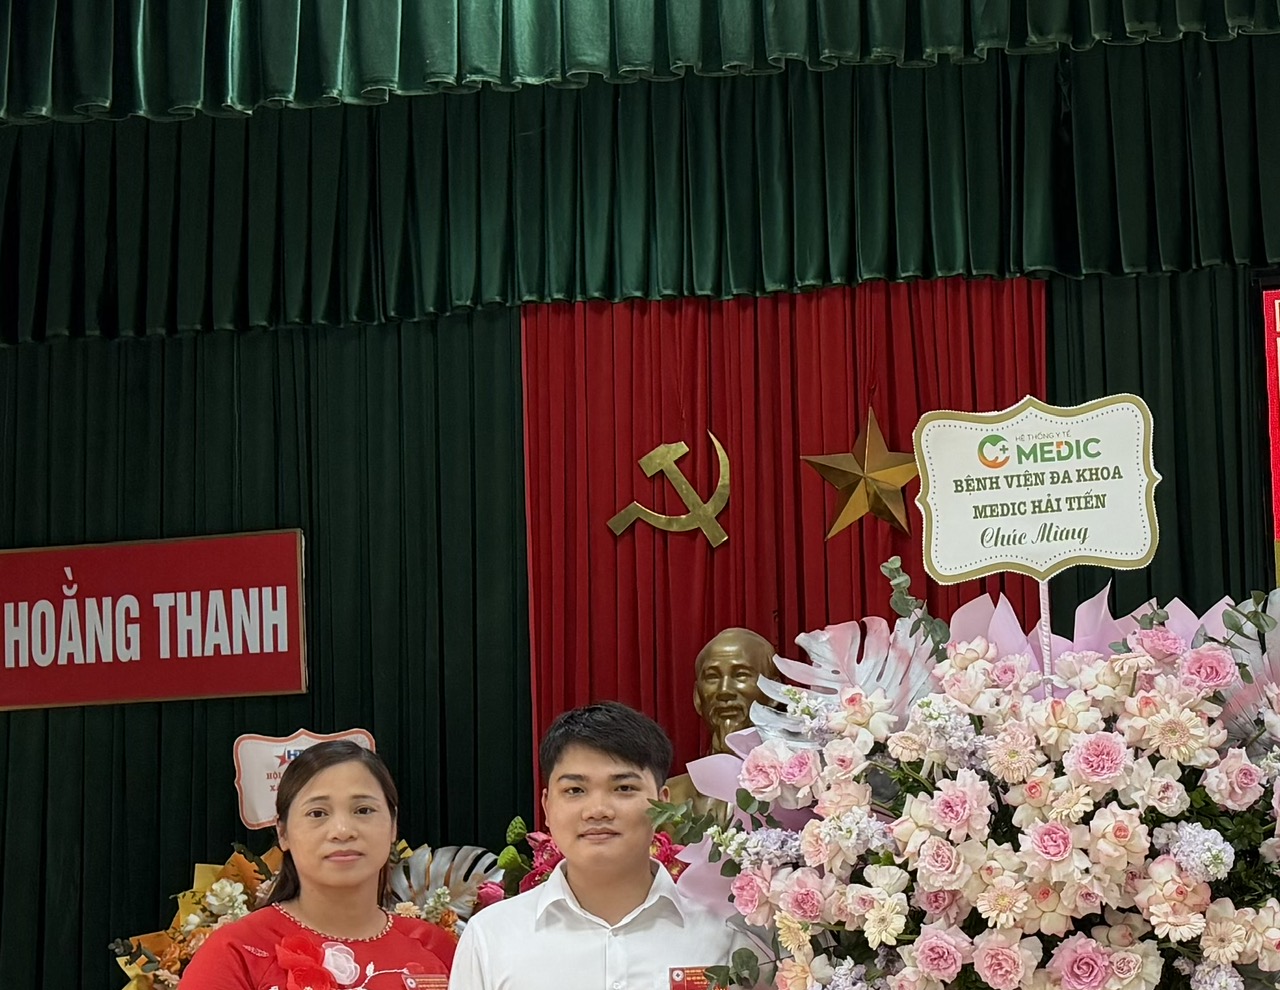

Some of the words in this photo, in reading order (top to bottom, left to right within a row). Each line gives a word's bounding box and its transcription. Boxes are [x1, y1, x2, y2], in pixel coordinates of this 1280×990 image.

[1016, 438, 1101, 464] MEDIC
[953, 474, 1000, 496] BỆNH
[1005, 470, 1045, 490] VIỆN
[1050, 468, 1073, 485] ĐA
[1076, 464, 1124, 482] KHOA
[972, 502, 1027, 519] MEDIC
[1030, 494, 1062, 514] HẢI
[1065, 488, 1107, 511] TIẾN
[980, 527, 1028, 549] Chúc
[1031, 522, 1090, 546] Mừng
[4, 566, 141, 668] HOẰNG
[153, 585, 289, 659] THANH
